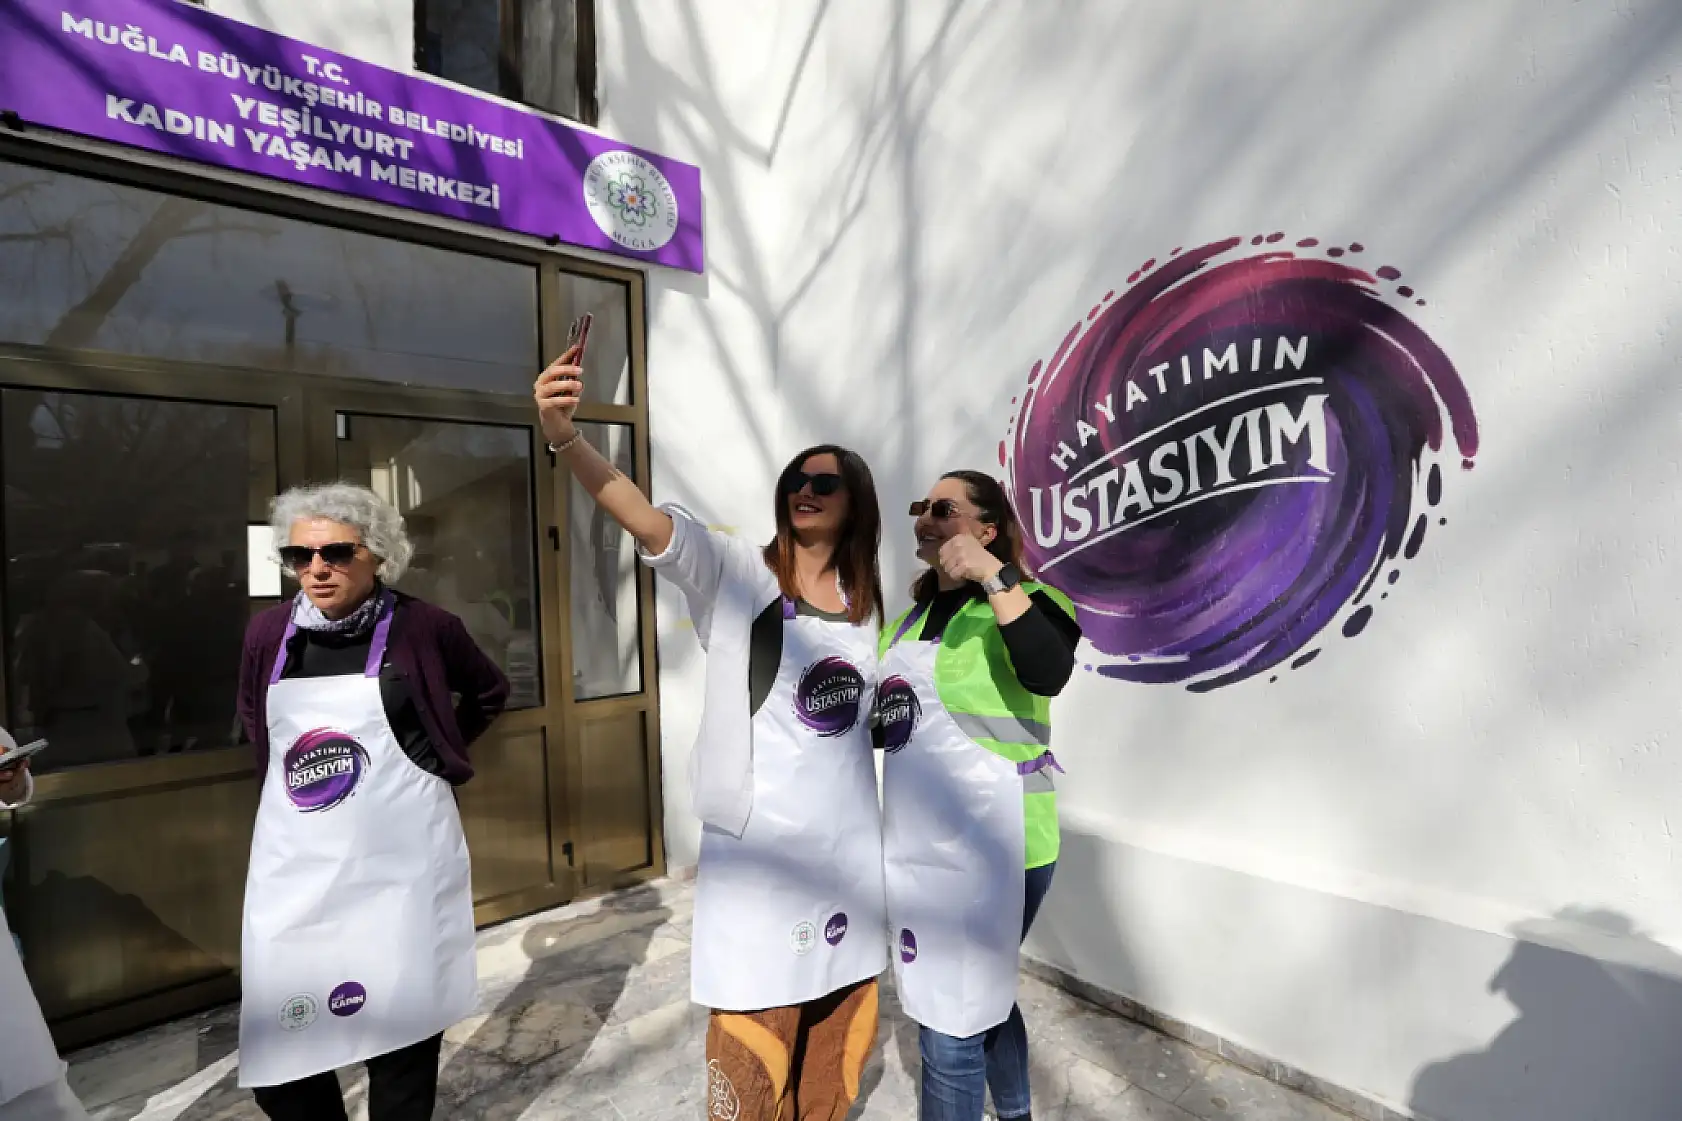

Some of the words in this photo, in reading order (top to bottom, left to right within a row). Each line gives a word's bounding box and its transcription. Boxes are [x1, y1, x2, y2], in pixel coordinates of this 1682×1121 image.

[61, 11, 190, 67] MUĞLA
[197, 50, 383, 120] BÜYÜKŞEHİR
[388, 105, 524, 160] BELEDİYESİ
[302, 55, 350, 85] T.C.
[105, 93, 236, 148] KADIN
[244, 128, 362, 177] YAŞAM
[370, 159, 500, 211] MERKEZİ
[231, 93, 414, 161] YEŞİLYURT
[1050, 336, 1309, 472] HAYATIMIN
[1030, 394, 1336, 549] USTASIYIM
[805, 687, 859, 712] USTASIYIM
[288, 757, 354, 787] USTASIYIM
